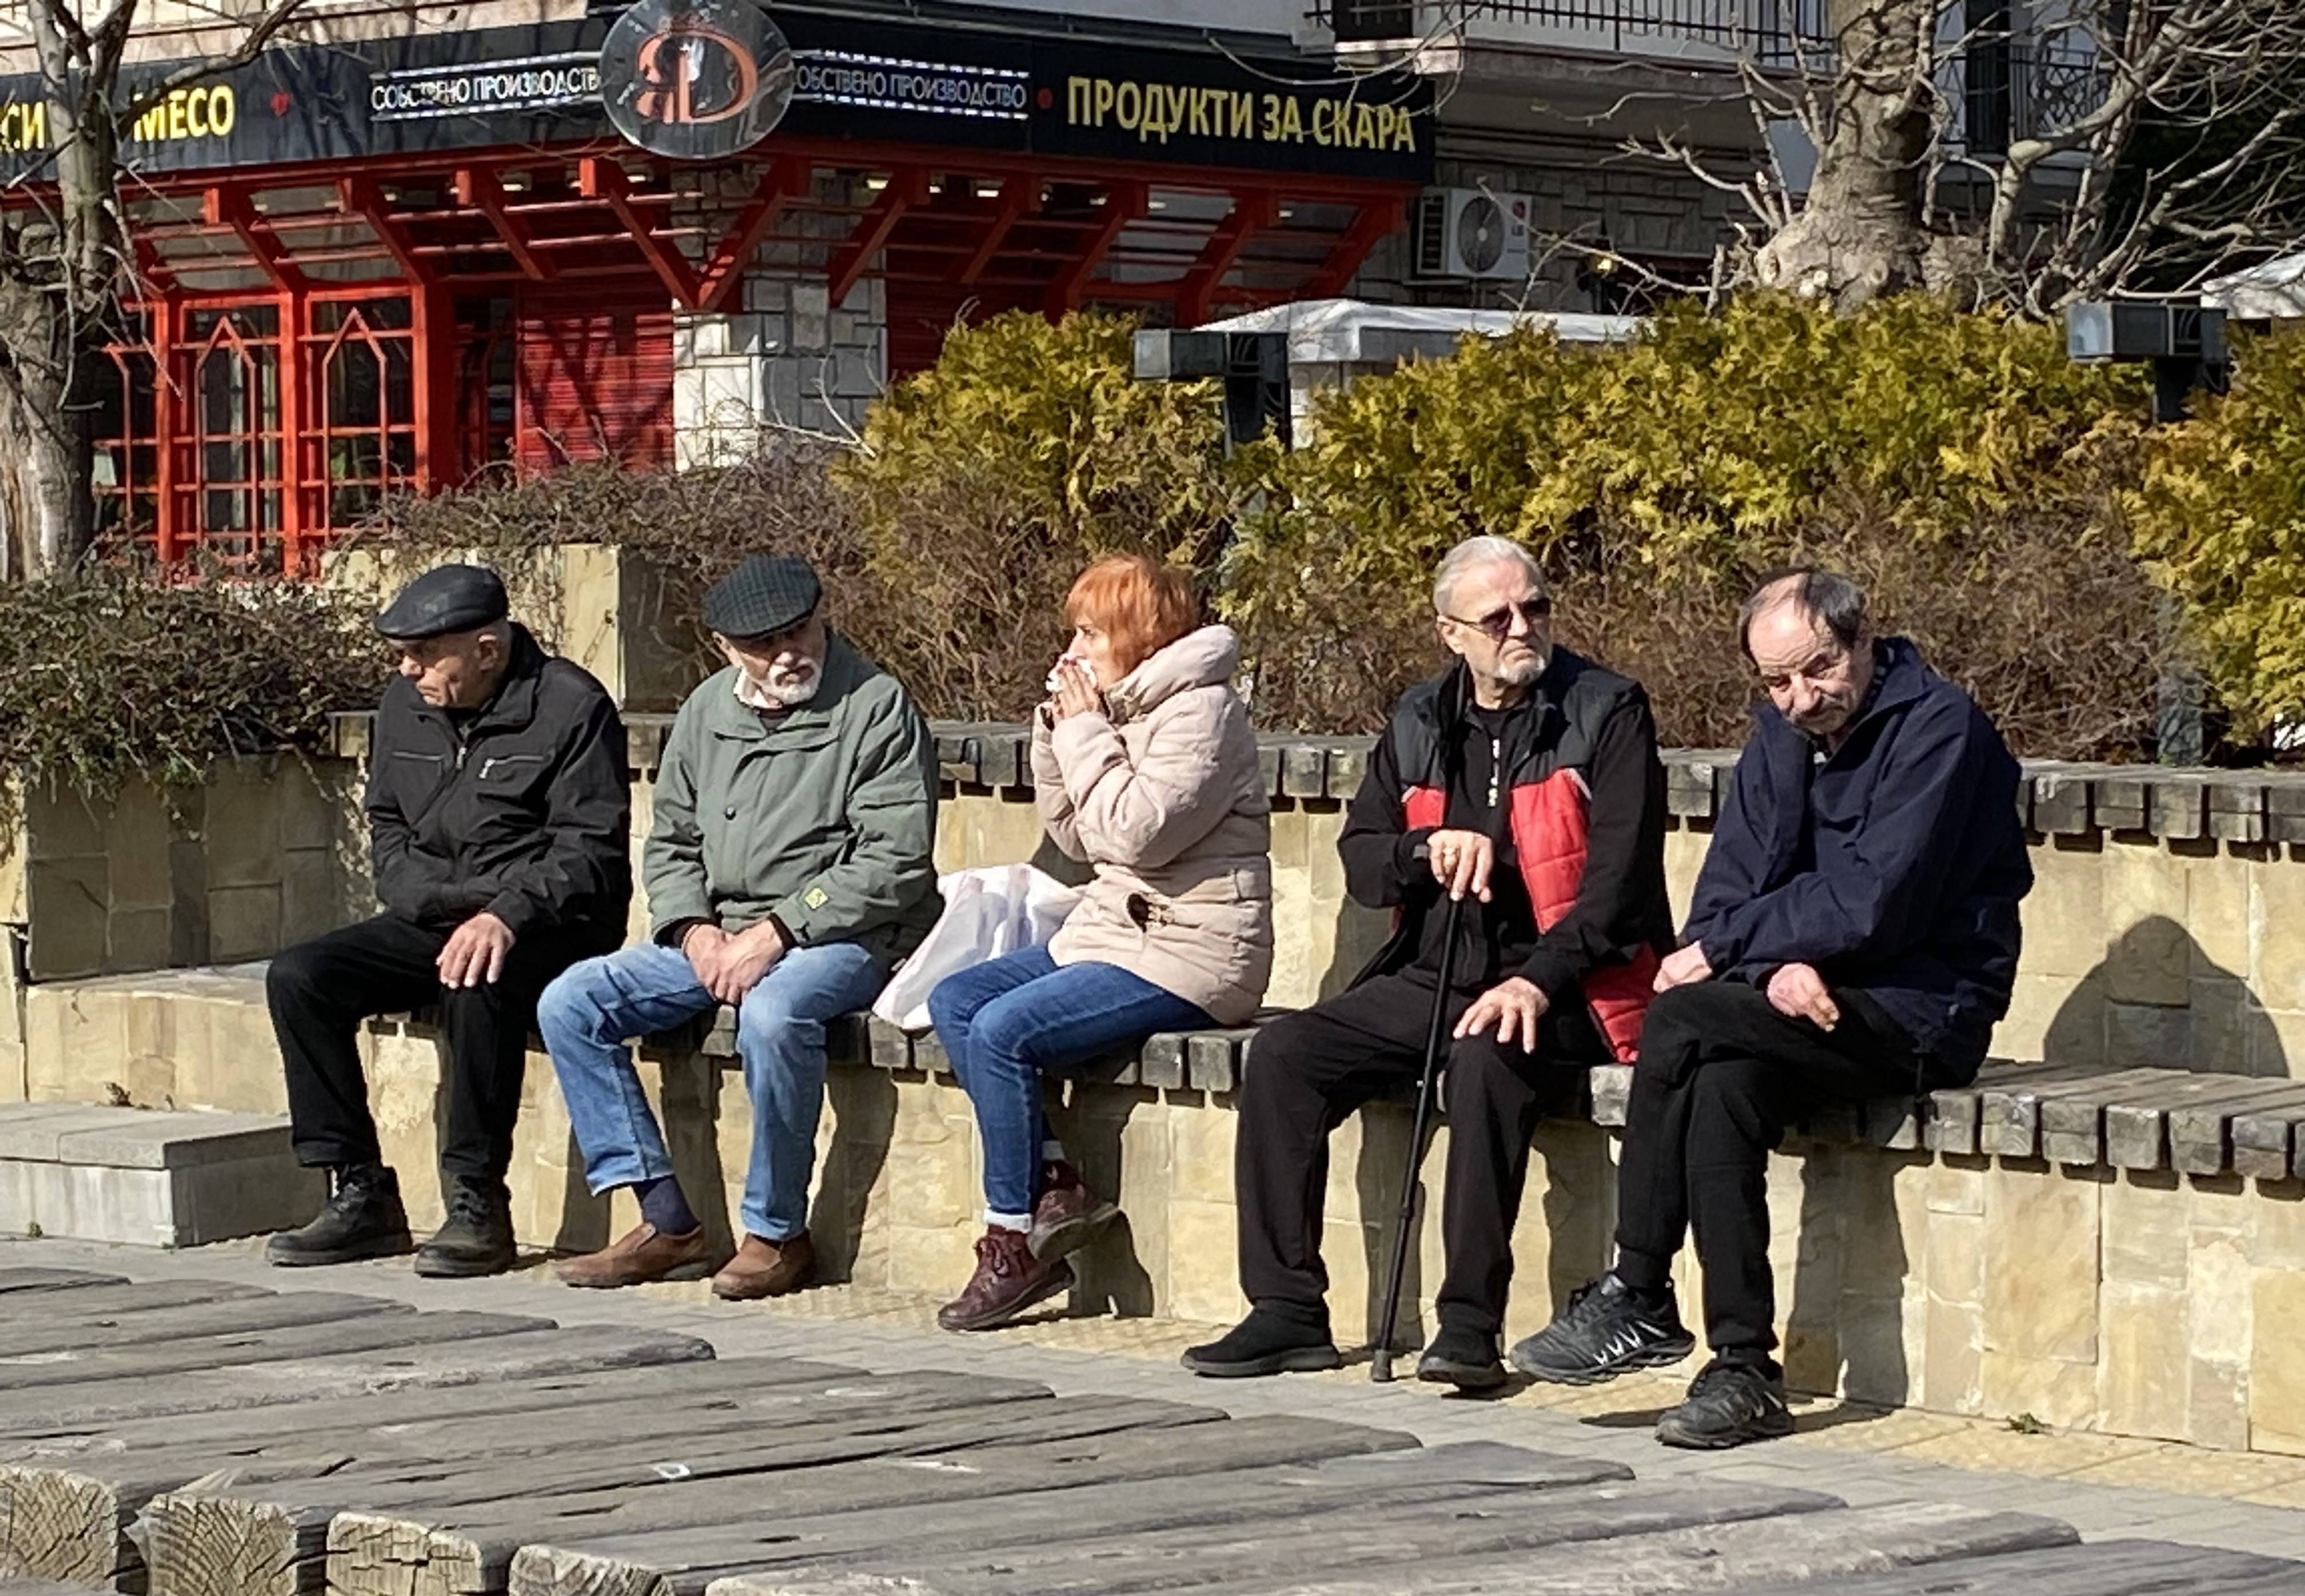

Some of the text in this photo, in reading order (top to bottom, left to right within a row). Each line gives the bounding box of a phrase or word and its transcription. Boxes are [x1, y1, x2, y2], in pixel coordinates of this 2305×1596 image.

[472, 66, 601, 101] ПРОИЗВОДСТВ
[796, 65, 1027, 109] ОБСТВЕНО ПРОИЗВОДСТВО
[0, 85, 234, 153] СИ МЕСО
[1067, 75, 1416, 153] ПРОДУКТИ ЗА СКАРА
